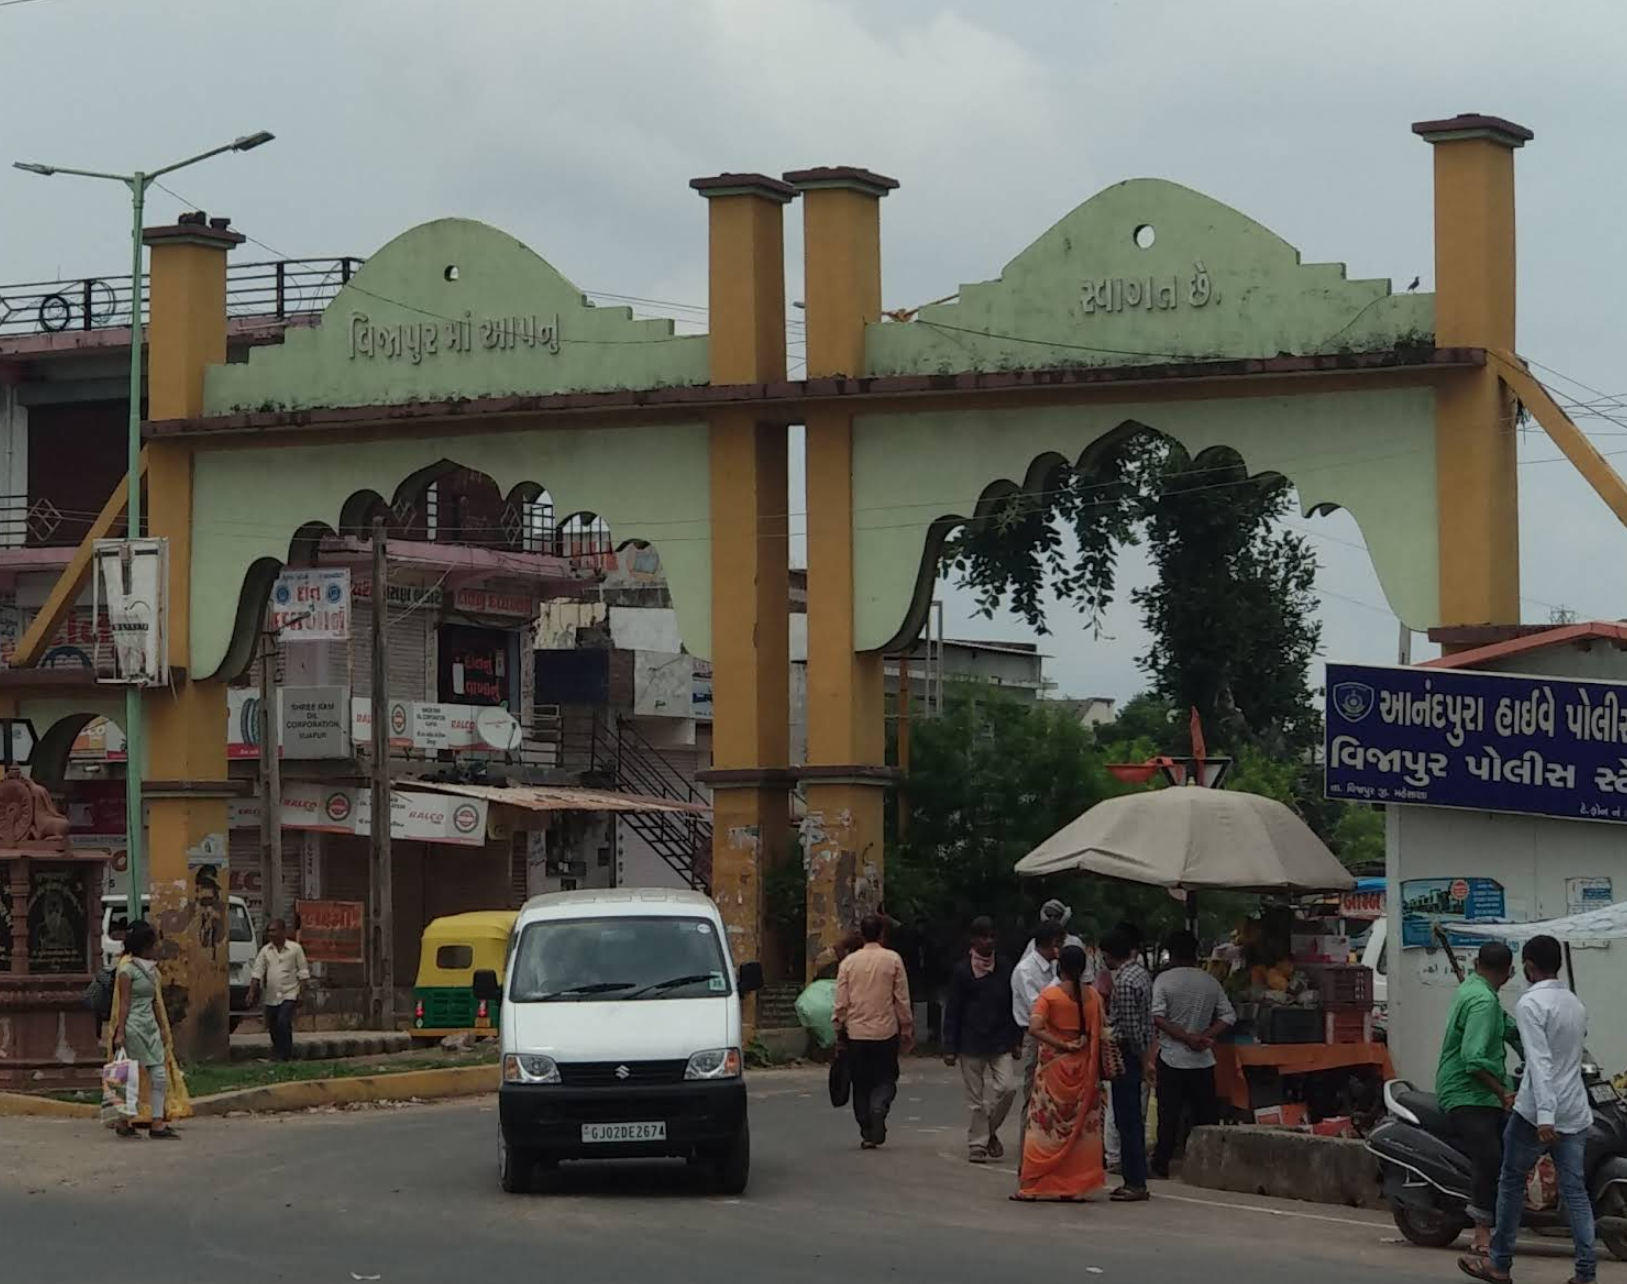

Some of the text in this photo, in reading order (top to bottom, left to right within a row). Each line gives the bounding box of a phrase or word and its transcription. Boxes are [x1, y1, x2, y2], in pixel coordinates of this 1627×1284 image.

[1081, 275, 1177, 313] સ્વાગત
[348, 311, 438, 364] વિજાપુર
[445, 310, 471, 352] માં
[286, 720, 340, 729] CORPORATION
[1379, 679, 1483, 748] આનંદપુરા
[1495, 686, 1555, 738] હાઈવે
[1330, 735, 1448, 787] વિજાપુર
[1465, 745, 1576, 789] પોલીસ
[409, 810, 444, 821] RALCO
[591, 1124, 665, 1140] GJ02DE2674
